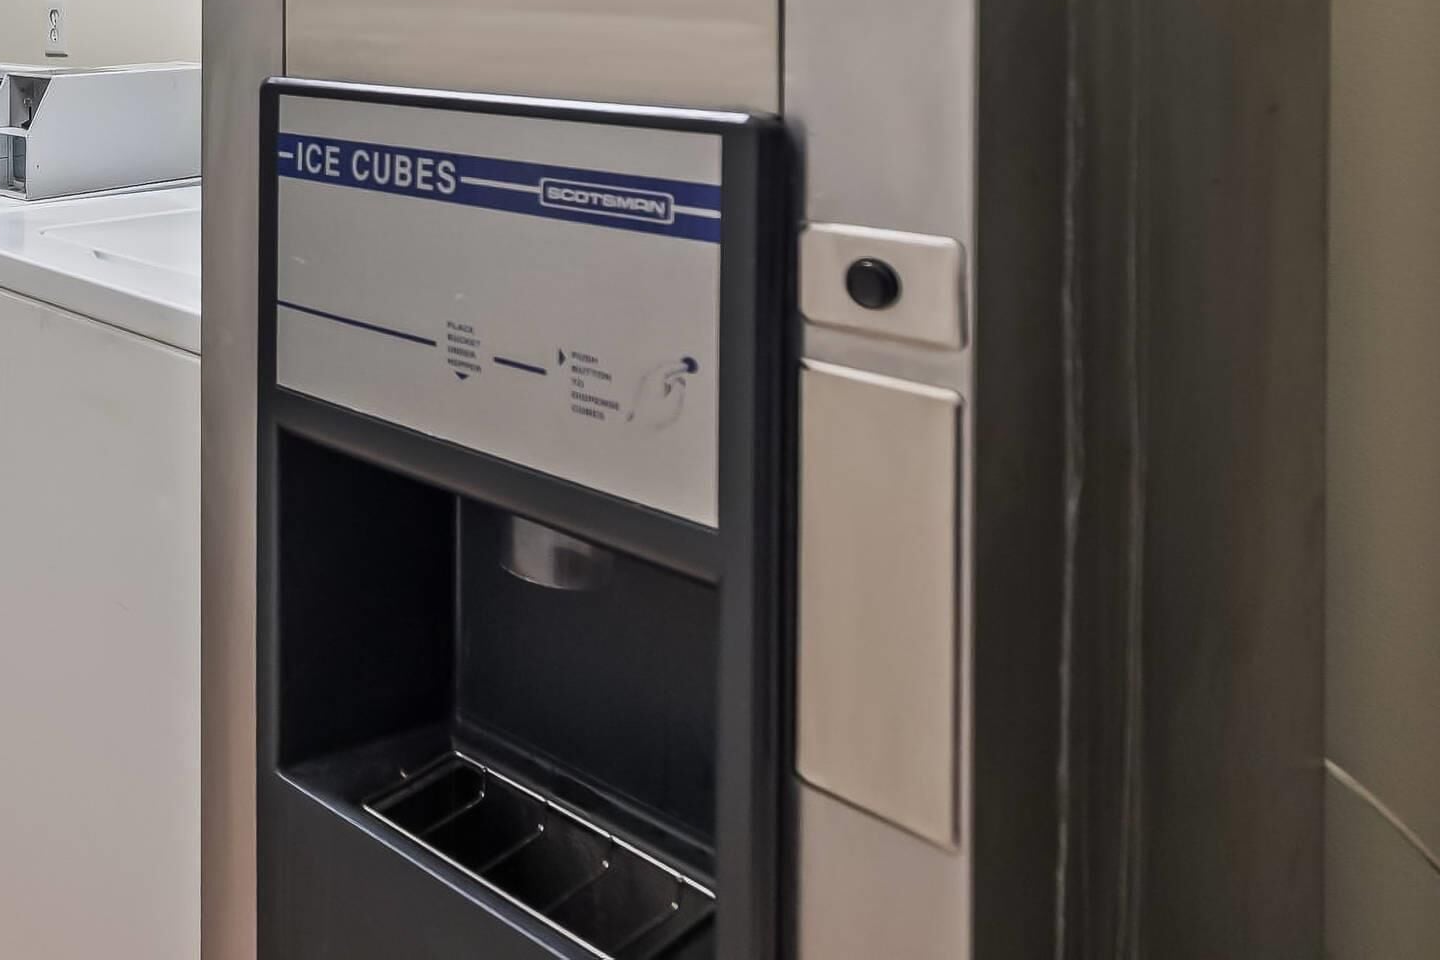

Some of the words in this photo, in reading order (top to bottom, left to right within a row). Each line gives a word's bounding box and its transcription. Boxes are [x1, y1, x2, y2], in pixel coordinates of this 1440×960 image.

[296, 142, 340, 177] ICE
[352, 150, 456, 195] CUBES
[547, 186, 665, 219] SCOTSMAN
[571, 365, 612, 381] BUTTON
